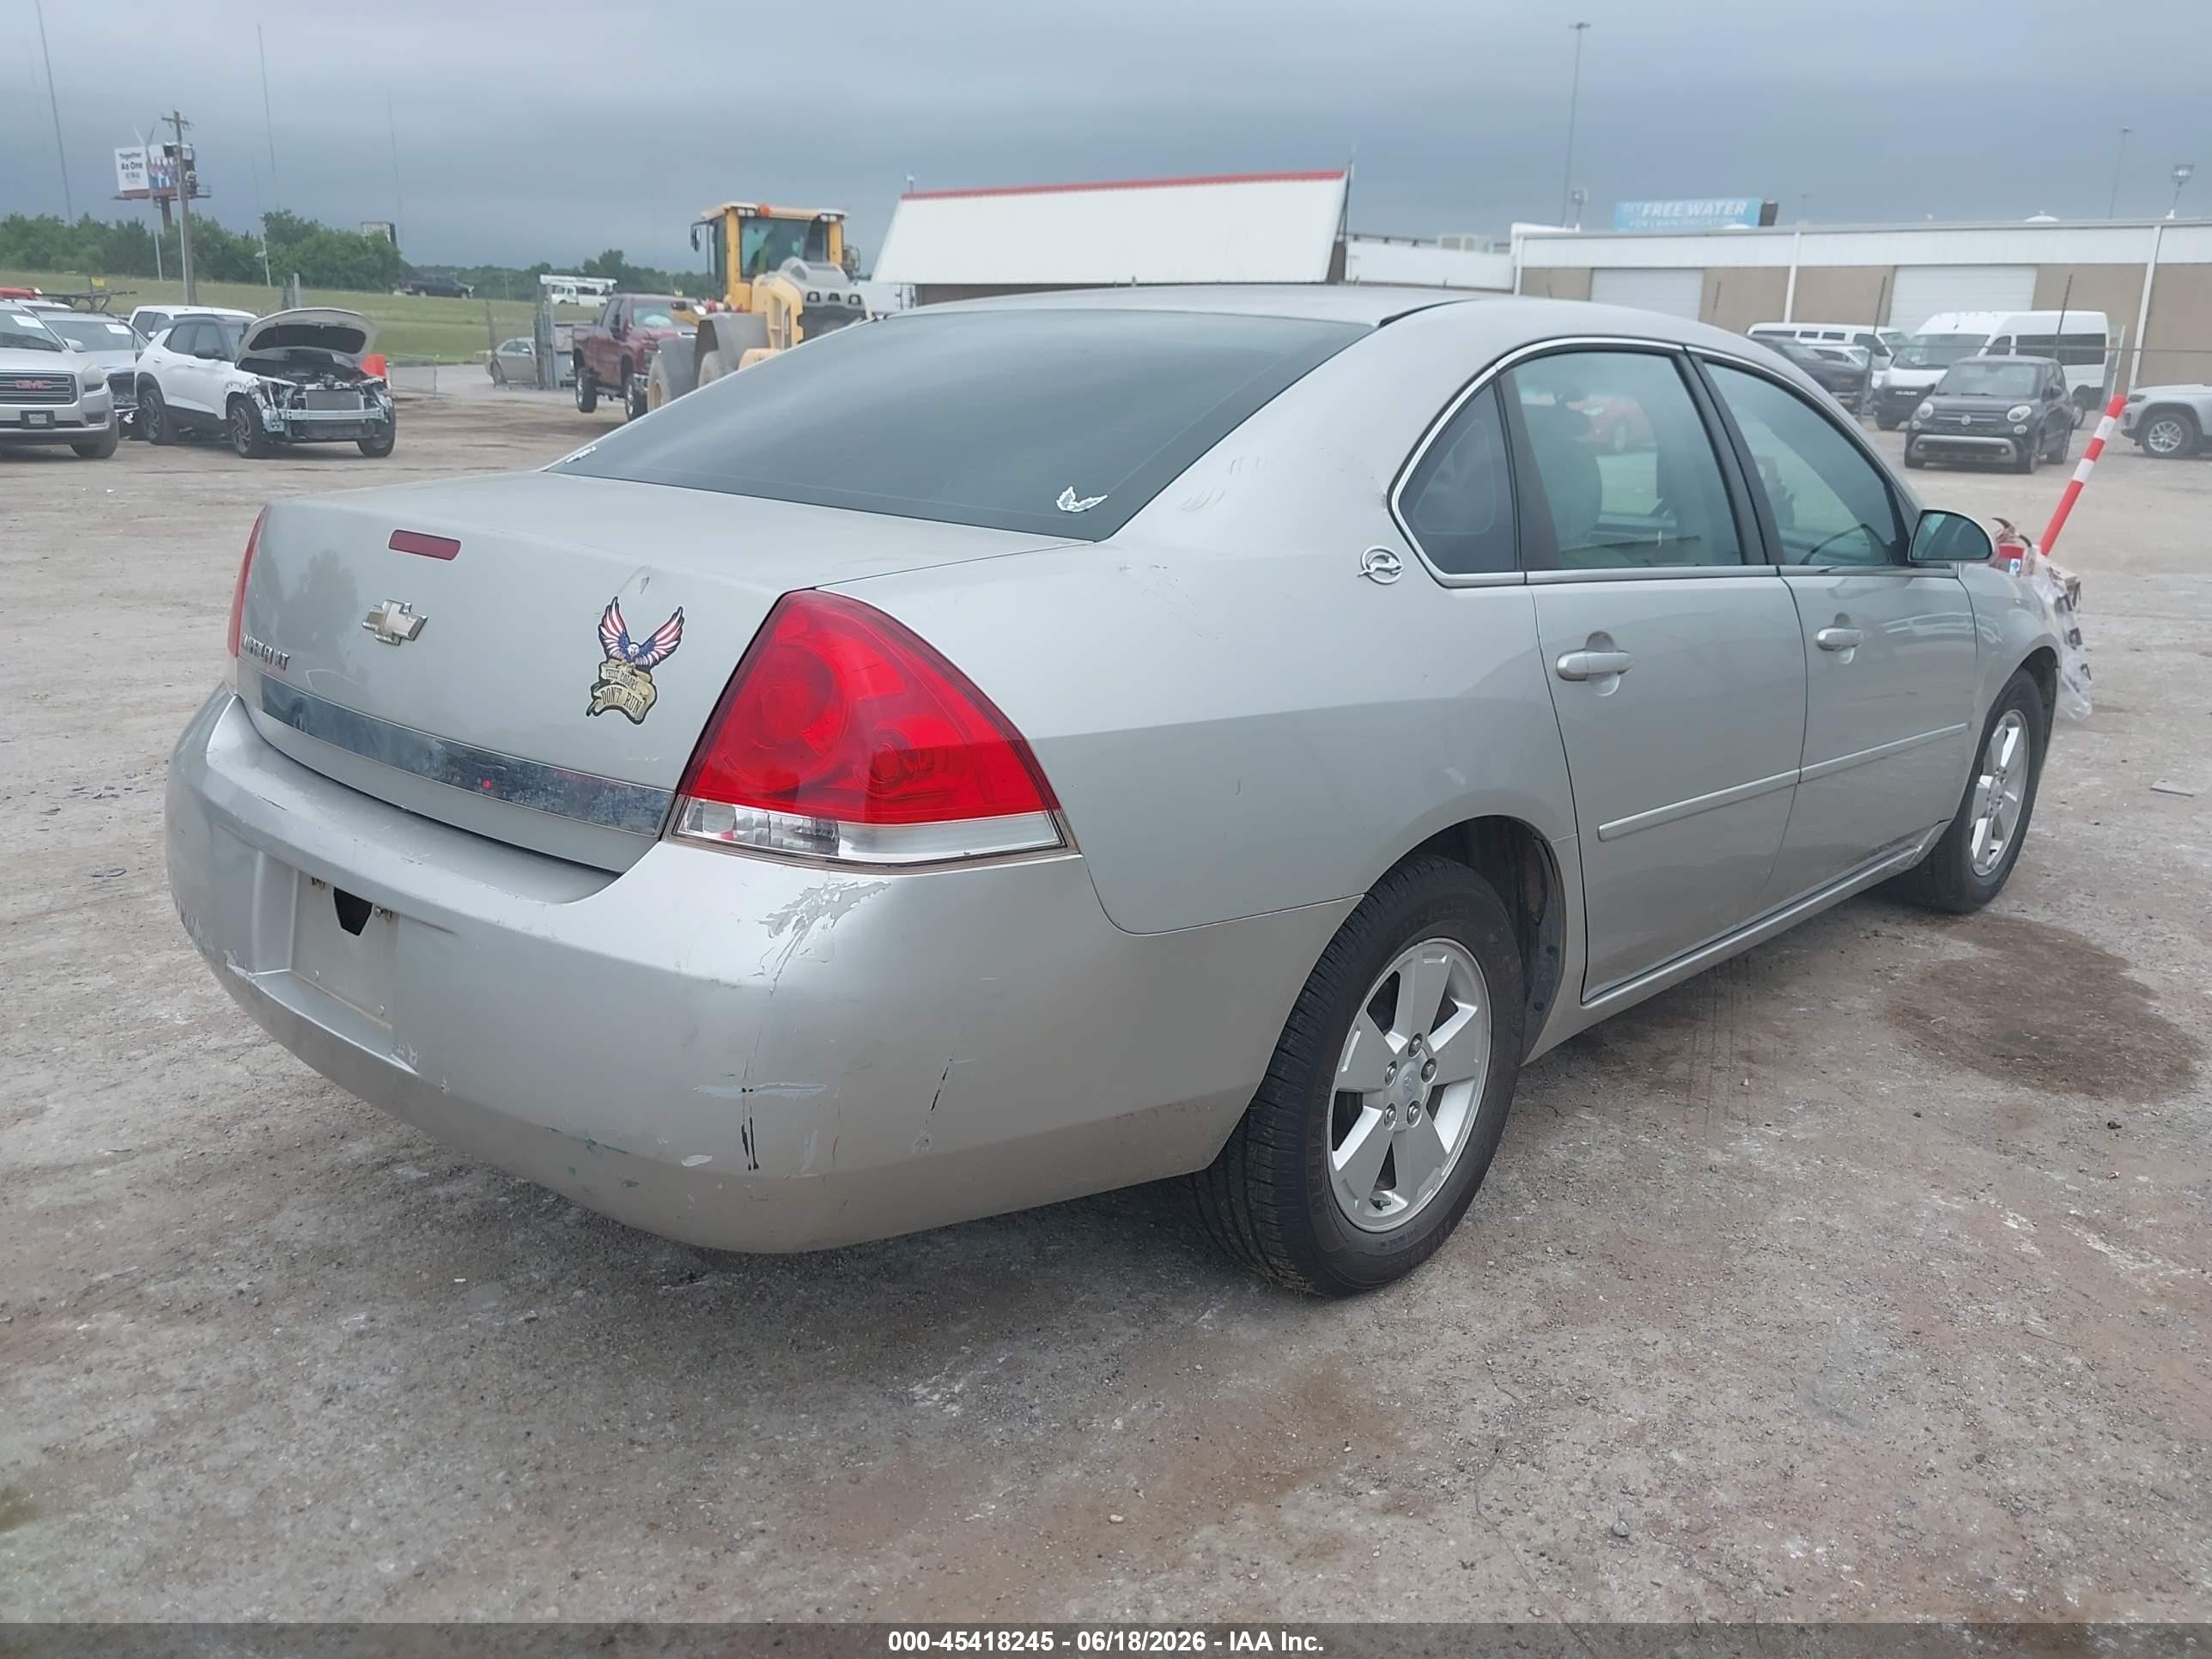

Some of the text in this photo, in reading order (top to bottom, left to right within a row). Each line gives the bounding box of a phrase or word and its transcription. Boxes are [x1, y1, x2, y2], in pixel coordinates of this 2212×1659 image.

[1642, 202, 1685, 216] FREE
[1688, 200, 1747, 216] WATER
[14, 380, 52, 390] GMC
[624, 692, 641, 714] RUN
